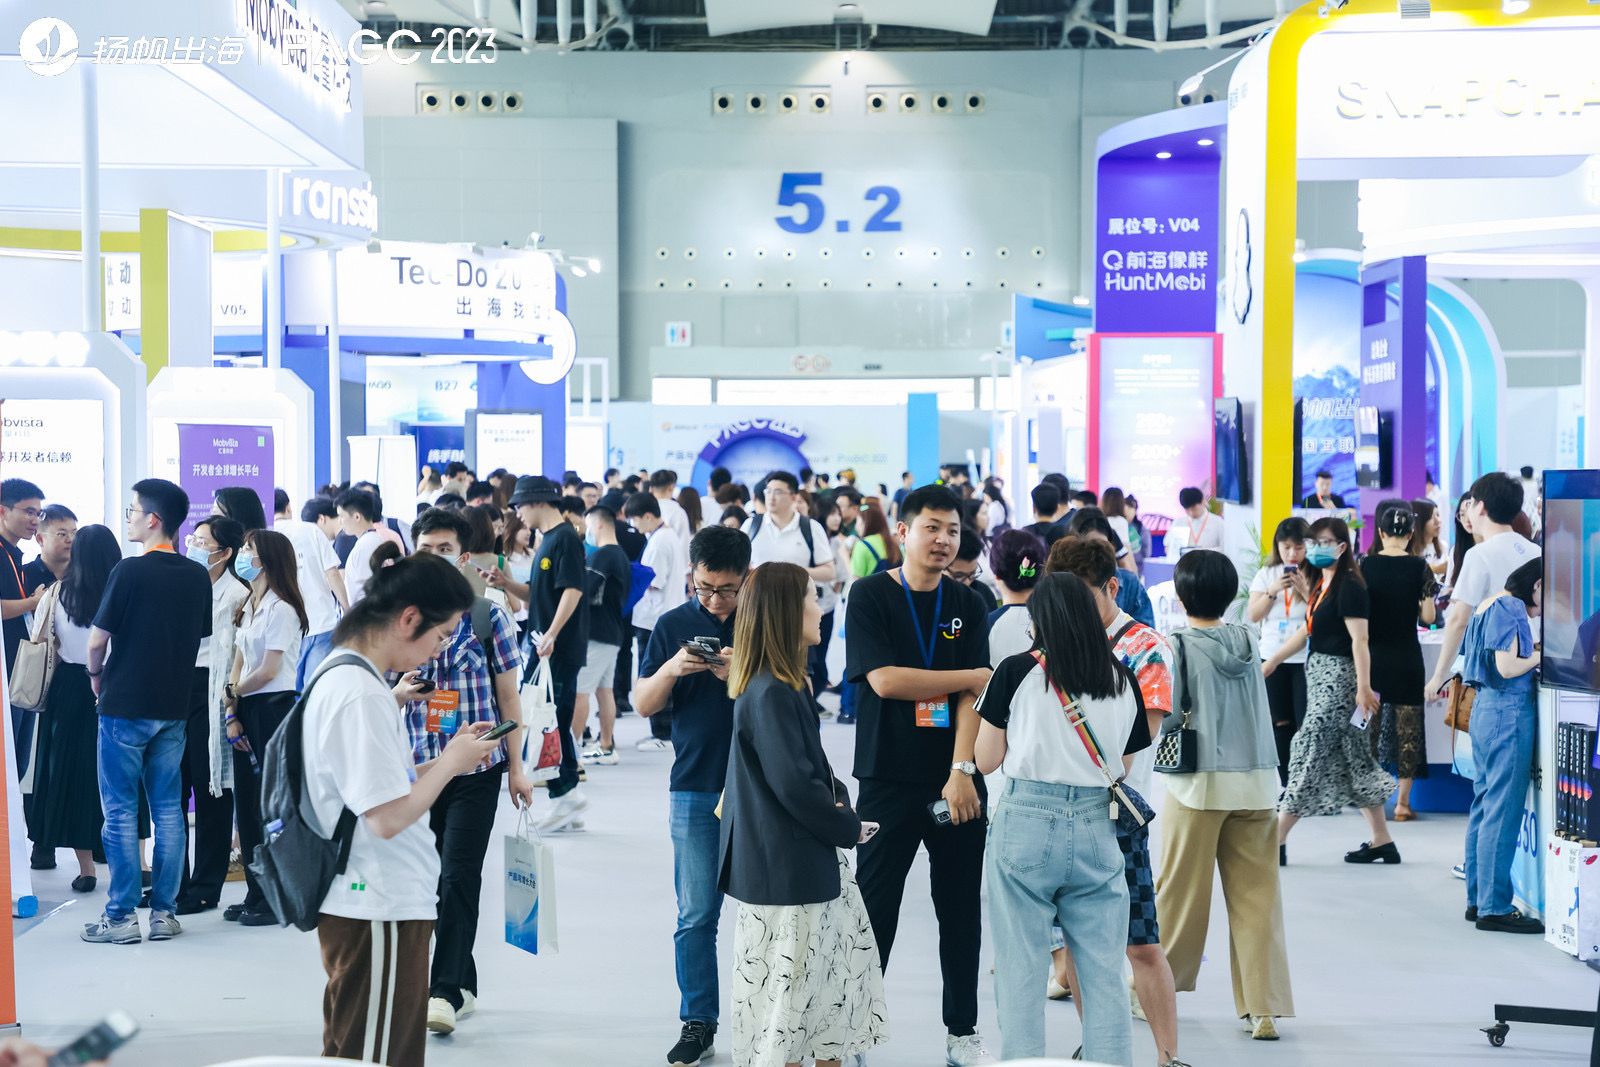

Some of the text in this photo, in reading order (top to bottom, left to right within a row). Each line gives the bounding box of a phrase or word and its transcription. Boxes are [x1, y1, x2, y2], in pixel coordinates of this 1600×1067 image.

[775, 172, 903, 234] 5.2
[1126, 250, 1209, 270] 前海像样
[1104, 272, 1206, 291] HuntMobi
[220, 304, 247, 315] V05
[435, 380, 459, 391] B27
[3, 417, 44, 428] bvista
[192, 464, 260, 477] 开发者全球增长平台
[918, 702, 946, 711] 参会证
